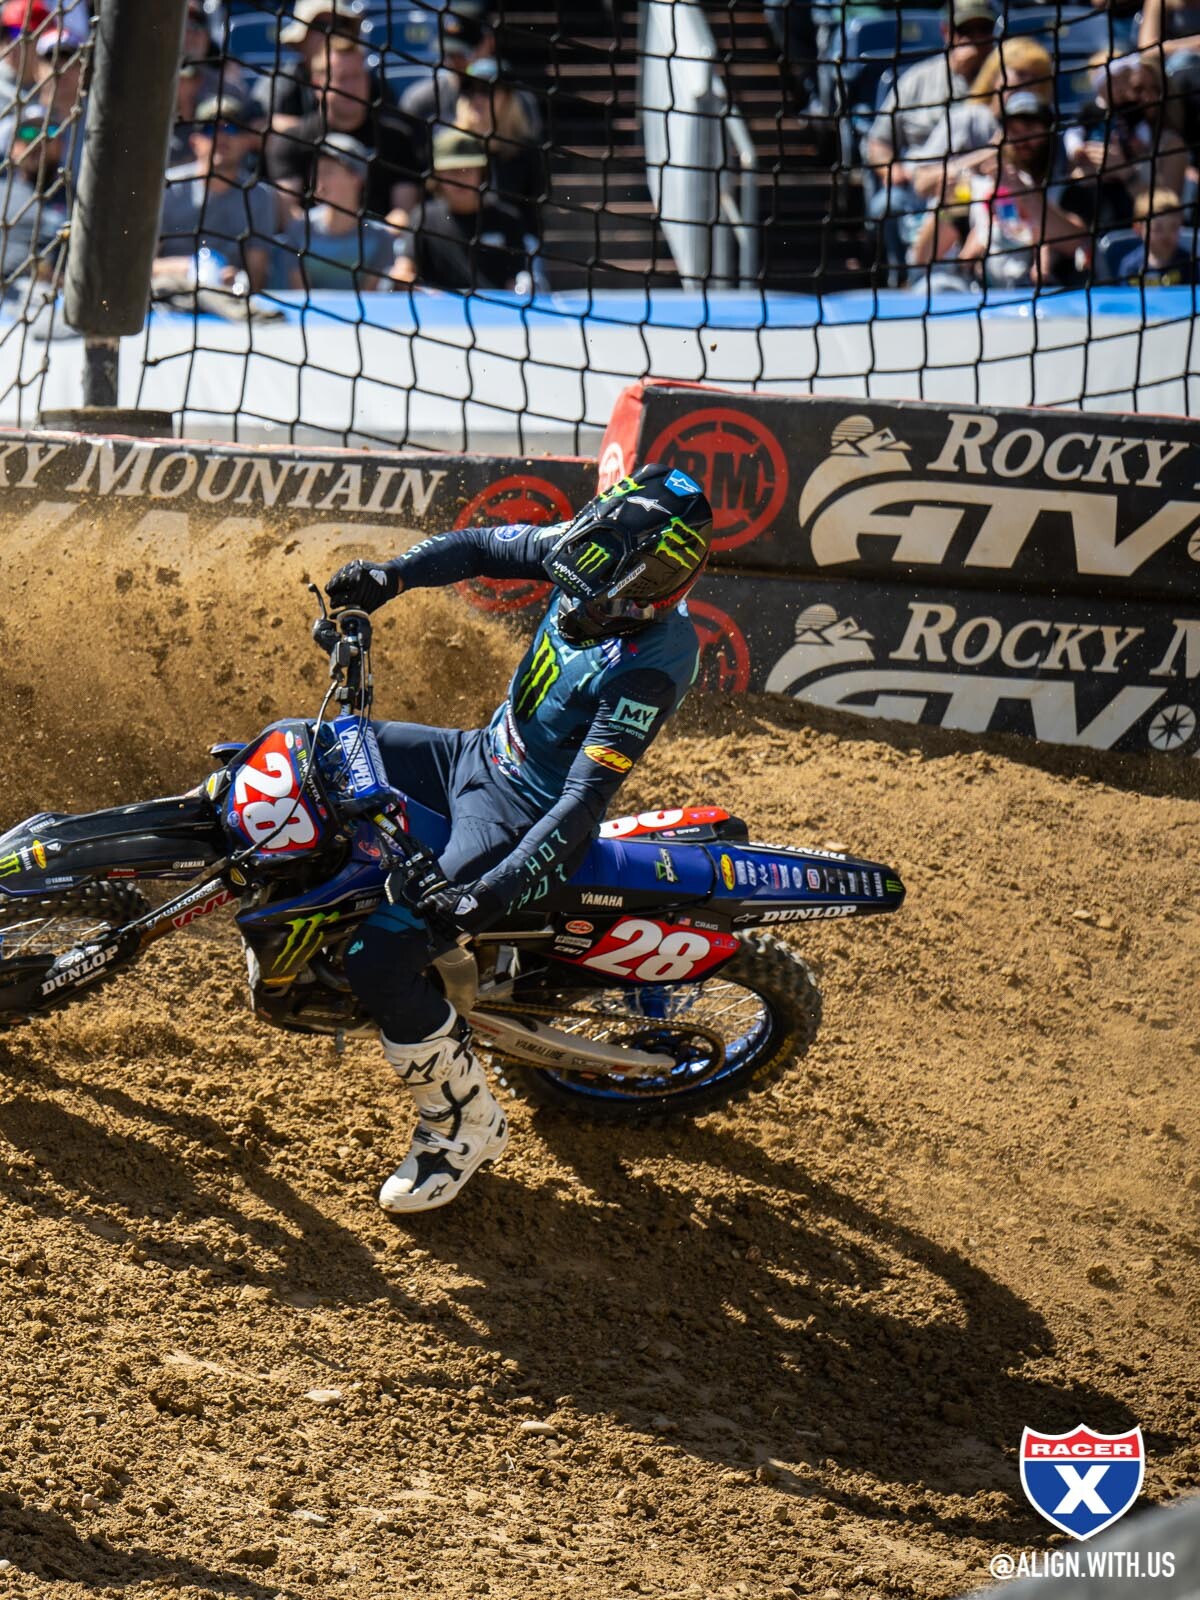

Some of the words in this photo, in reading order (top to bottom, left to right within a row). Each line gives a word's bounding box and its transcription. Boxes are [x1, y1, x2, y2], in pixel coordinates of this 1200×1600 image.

[70, 434, 448, 516] MOUNTAIN
[926, 412, 1190, 490] ROCKY
[552, 560, 594, 596] MONSTER
[890, 601, 1145, 675] ROCKY
[234, 752, 316, 849] 28
[180, 860, 205, 869] YAMAHA
[581, 891, 624, 908] YAMAHA
[694, 920, 719, 932] CRAIG
[759, 905, 857, 923] DUNLOP
[41, 943, 119, 996] DUNLOP
[583, 918, 711, 982] 28
